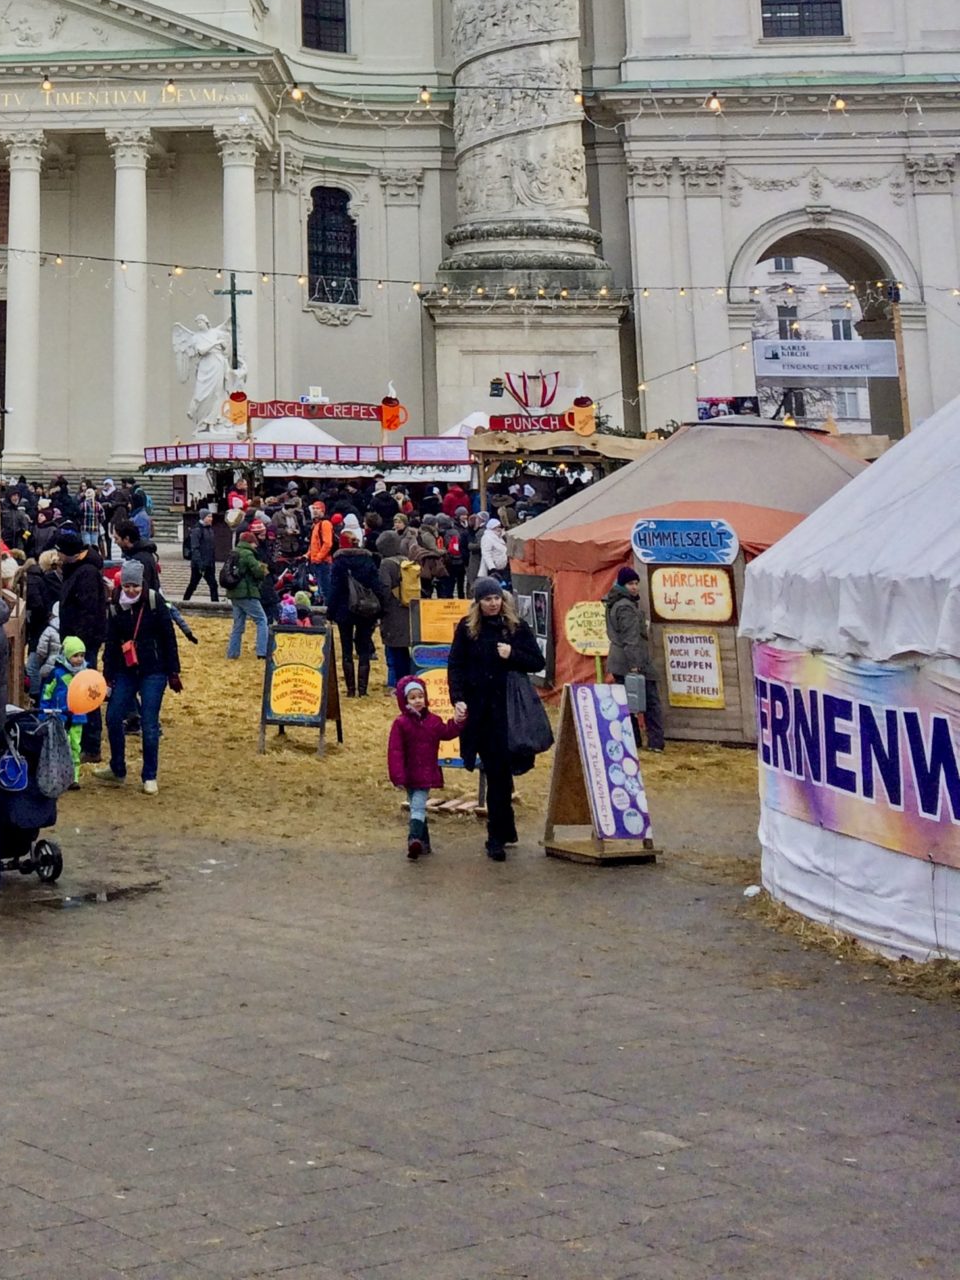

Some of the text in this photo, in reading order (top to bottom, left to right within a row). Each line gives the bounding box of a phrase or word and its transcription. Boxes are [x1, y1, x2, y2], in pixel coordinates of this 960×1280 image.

[43, 90, 147, 106] TIMENTIVM
[781, 363, 820, 371] EINGANG
[827, 363, 872, 371] ENTRANCE
[247, 402, 305, 417] PUNSCH
[323, 404, 378, 419] CREPES
[504, 416, 559, 430] PUNSCH
[637, 530, 727, 548] HIMMELSZELT
[662, 571, 719, 588] MÄRCHEN
[667, 635, 715, 645] VORMITTAG
[669, 647, 712, 657] AUCH FÜR
[669, 660, 713, 670] GRUPPEN
[671, 673, 705, 684] KERZEN
[686, 685, 719, 696] ZIEHEN
[755, 676, 960, 822] ERNENW
